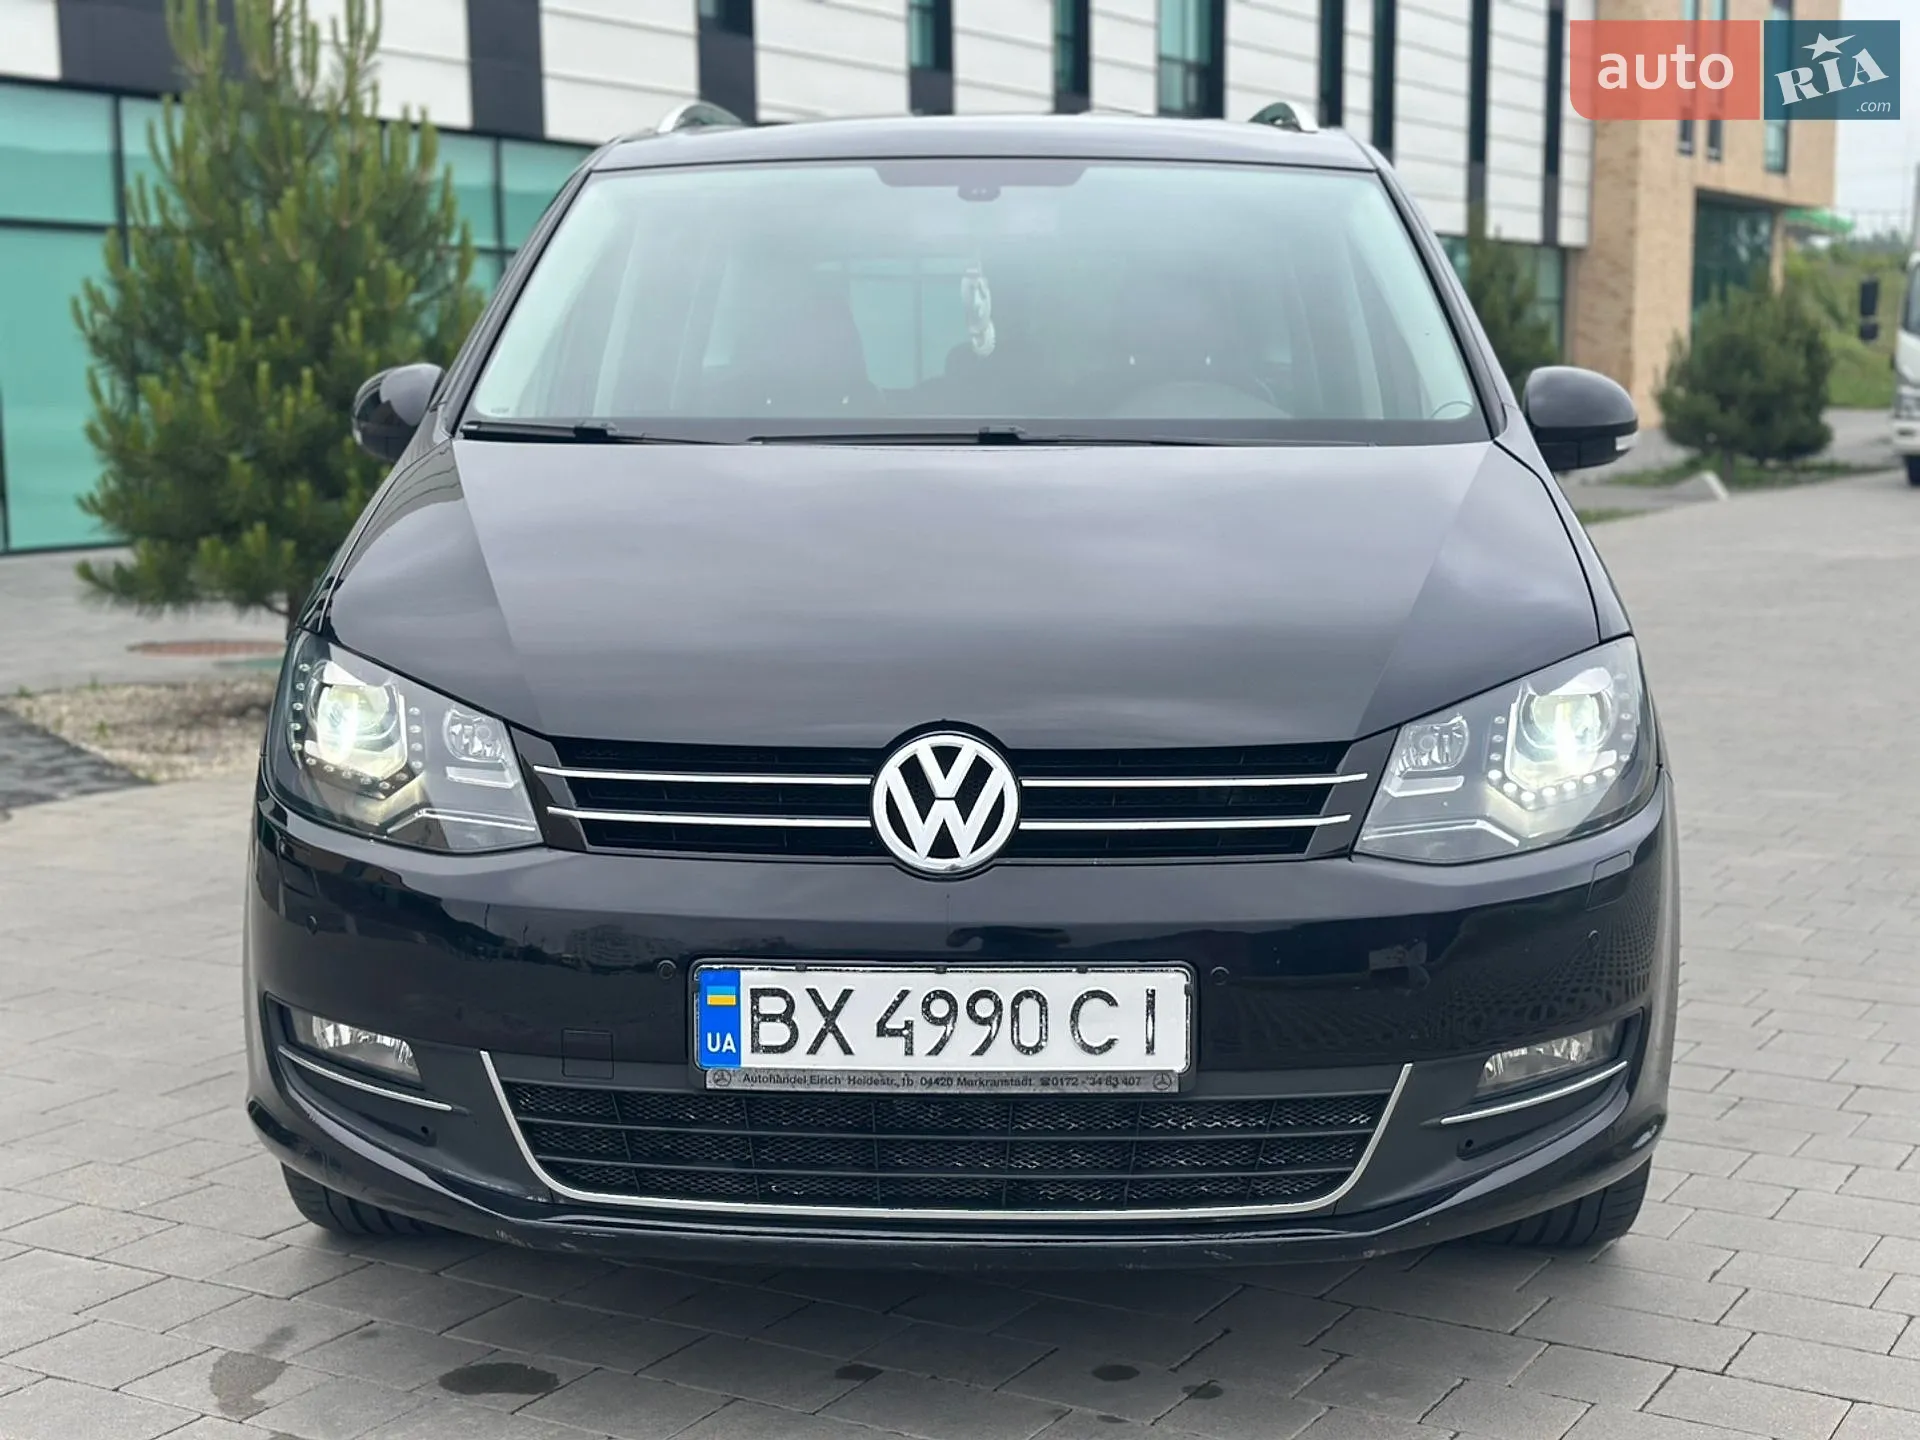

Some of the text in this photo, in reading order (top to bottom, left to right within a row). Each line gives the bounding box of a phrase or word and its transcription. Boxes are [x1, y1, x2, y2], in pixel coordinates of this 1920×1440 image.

[749, 987, 855, 1056] BX
[875, 988, 1049, 1057] 4990
[707, 1032, 736, 1054] UA
[742, 1072, 808, 1085] Autohandel
